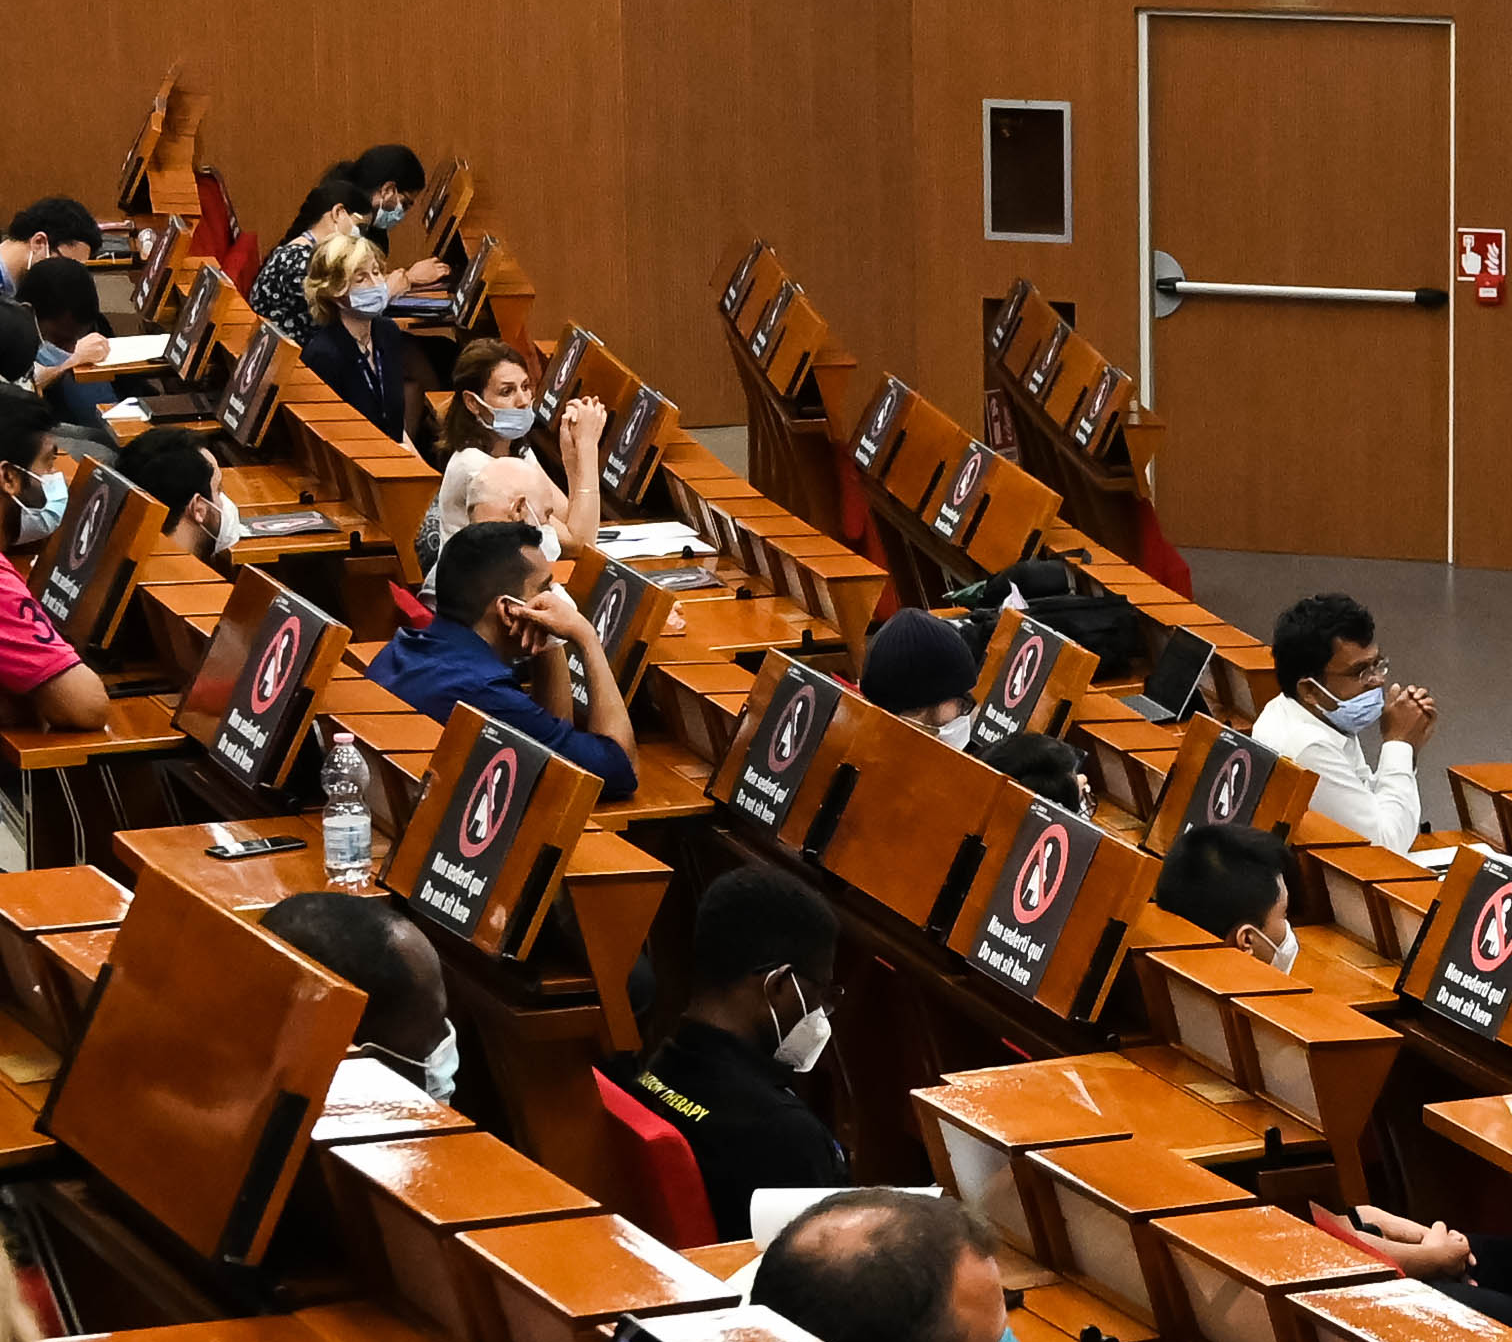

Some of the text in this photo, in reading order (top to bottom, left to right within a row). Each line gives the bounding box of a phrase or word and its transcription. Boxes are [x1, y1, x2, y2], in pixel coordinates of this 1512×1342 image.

[431, 852, 488, 898] Non sederti qui
[420, 880, 470, 923] Do not sit here
[987, 914, 1046, 962] Non sederti qui
[978, 940, 1031, 985] Do not sit here
[1445, 962, 1507, 1005] Non sederti qui
[1436, 985, 1493, 1026] Do not sit here
[659, 1088, 710, 1122] THERAPY
